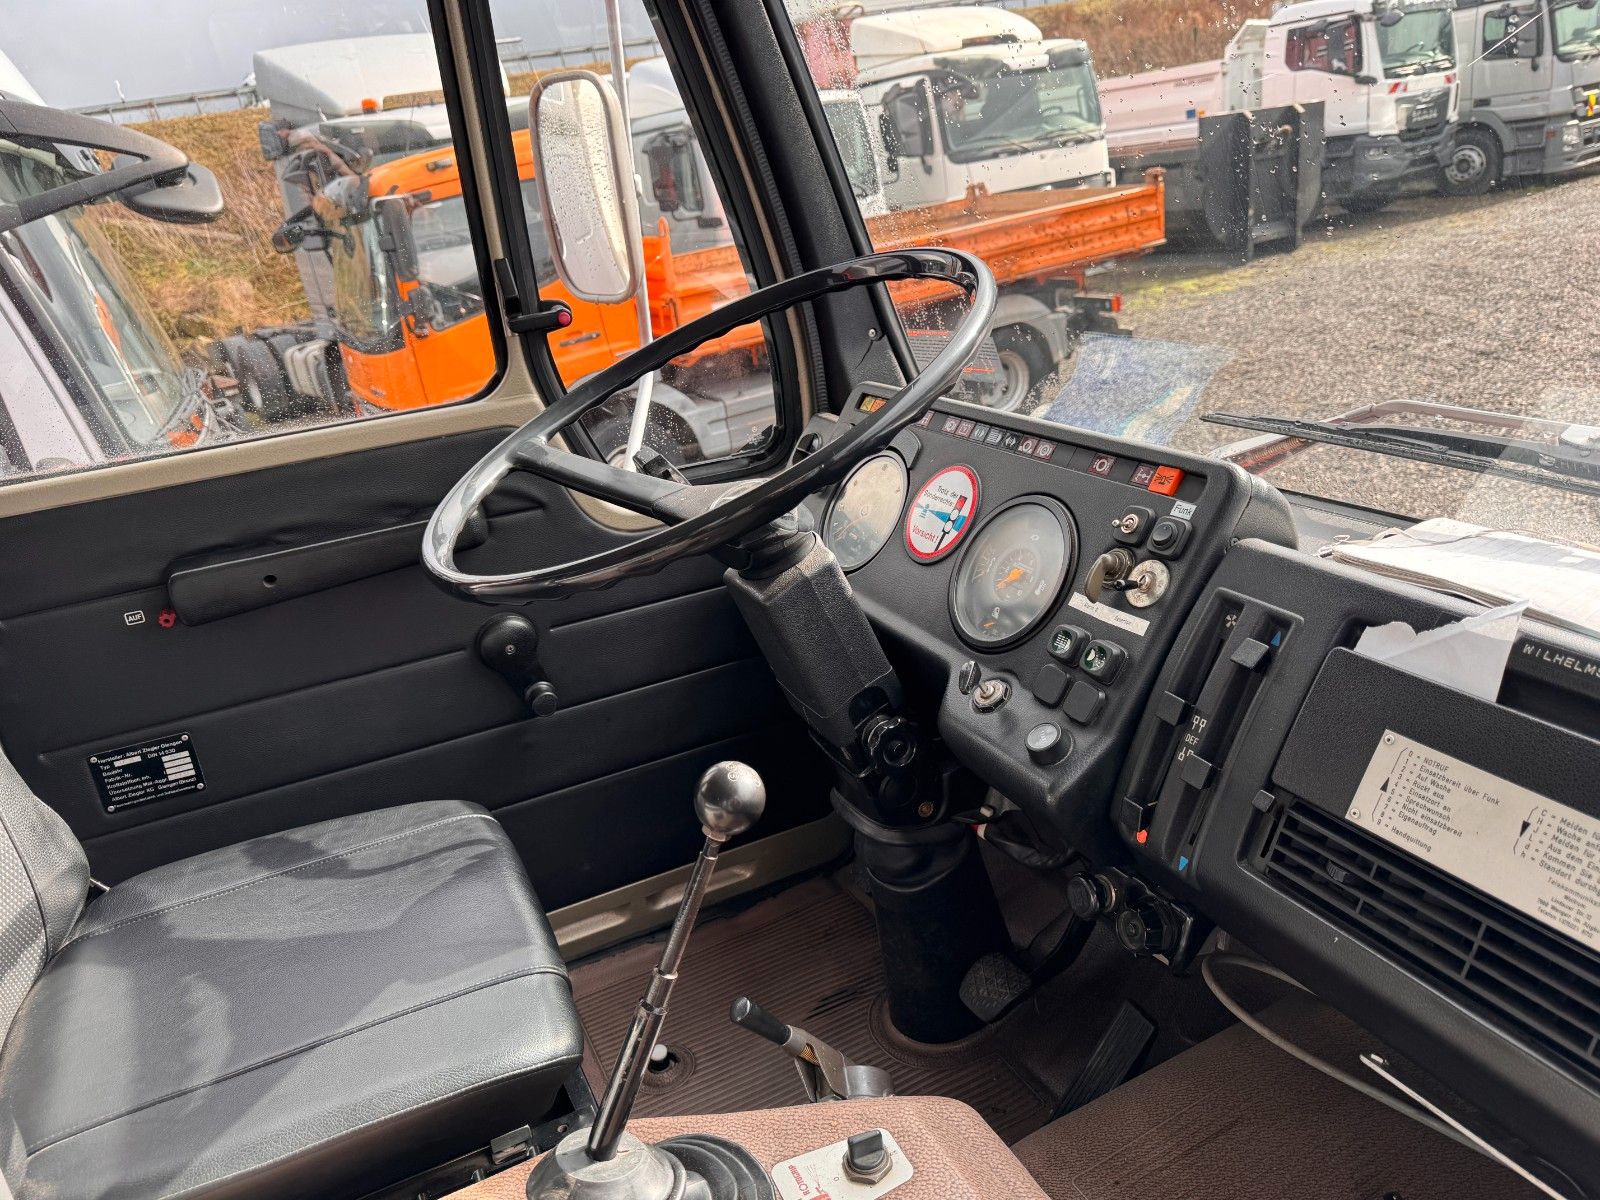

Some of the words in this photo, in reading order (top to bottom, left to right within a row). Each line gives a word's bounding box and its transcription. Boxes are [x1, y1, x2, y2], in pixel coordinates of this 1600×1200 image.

[1174, 504, 1193, 516] Funk
[1185, 733, 1199, 746] DEF
[1423, 757, 1449, 772] NOTRUF
[1412, 780, 1430, 793] Rückt
[1432, 791, 1444, 800] aus
[1416, 773, 1428, 782] Auf
[1430, 779, 1451, 794] Wache
[1419, 764, 1461, 789] Einsatzbereit
[1464, 785, 1479, 796] über
[1482, 792, 1500, 806] Funk
[1409, 787, 1440, 807] Einsatzort
[1405, 795, 1451, 822] Sprechwunsch
[1398, 810, 1437, 836] Eigenauftrag
[1401, 803, 1418, 816] Nicht
[1420, 814, 1462, 837] einsatzbereit
[1559, 817, 1588, 835] Melden
[1391, 825, 1432, 853] Handquittung
[1551, 834, 1579, 852] Melden
[1557, 825, 1582, 843] Wache
[1547, 843, 1562, 855] Aus
[1566, 852, 1583, 864] dem
[1539, 859, 1572, 880] Standort
[1543, 851, 1576, 872] Kommen
[1580, 869, 1593, 880] Sie
